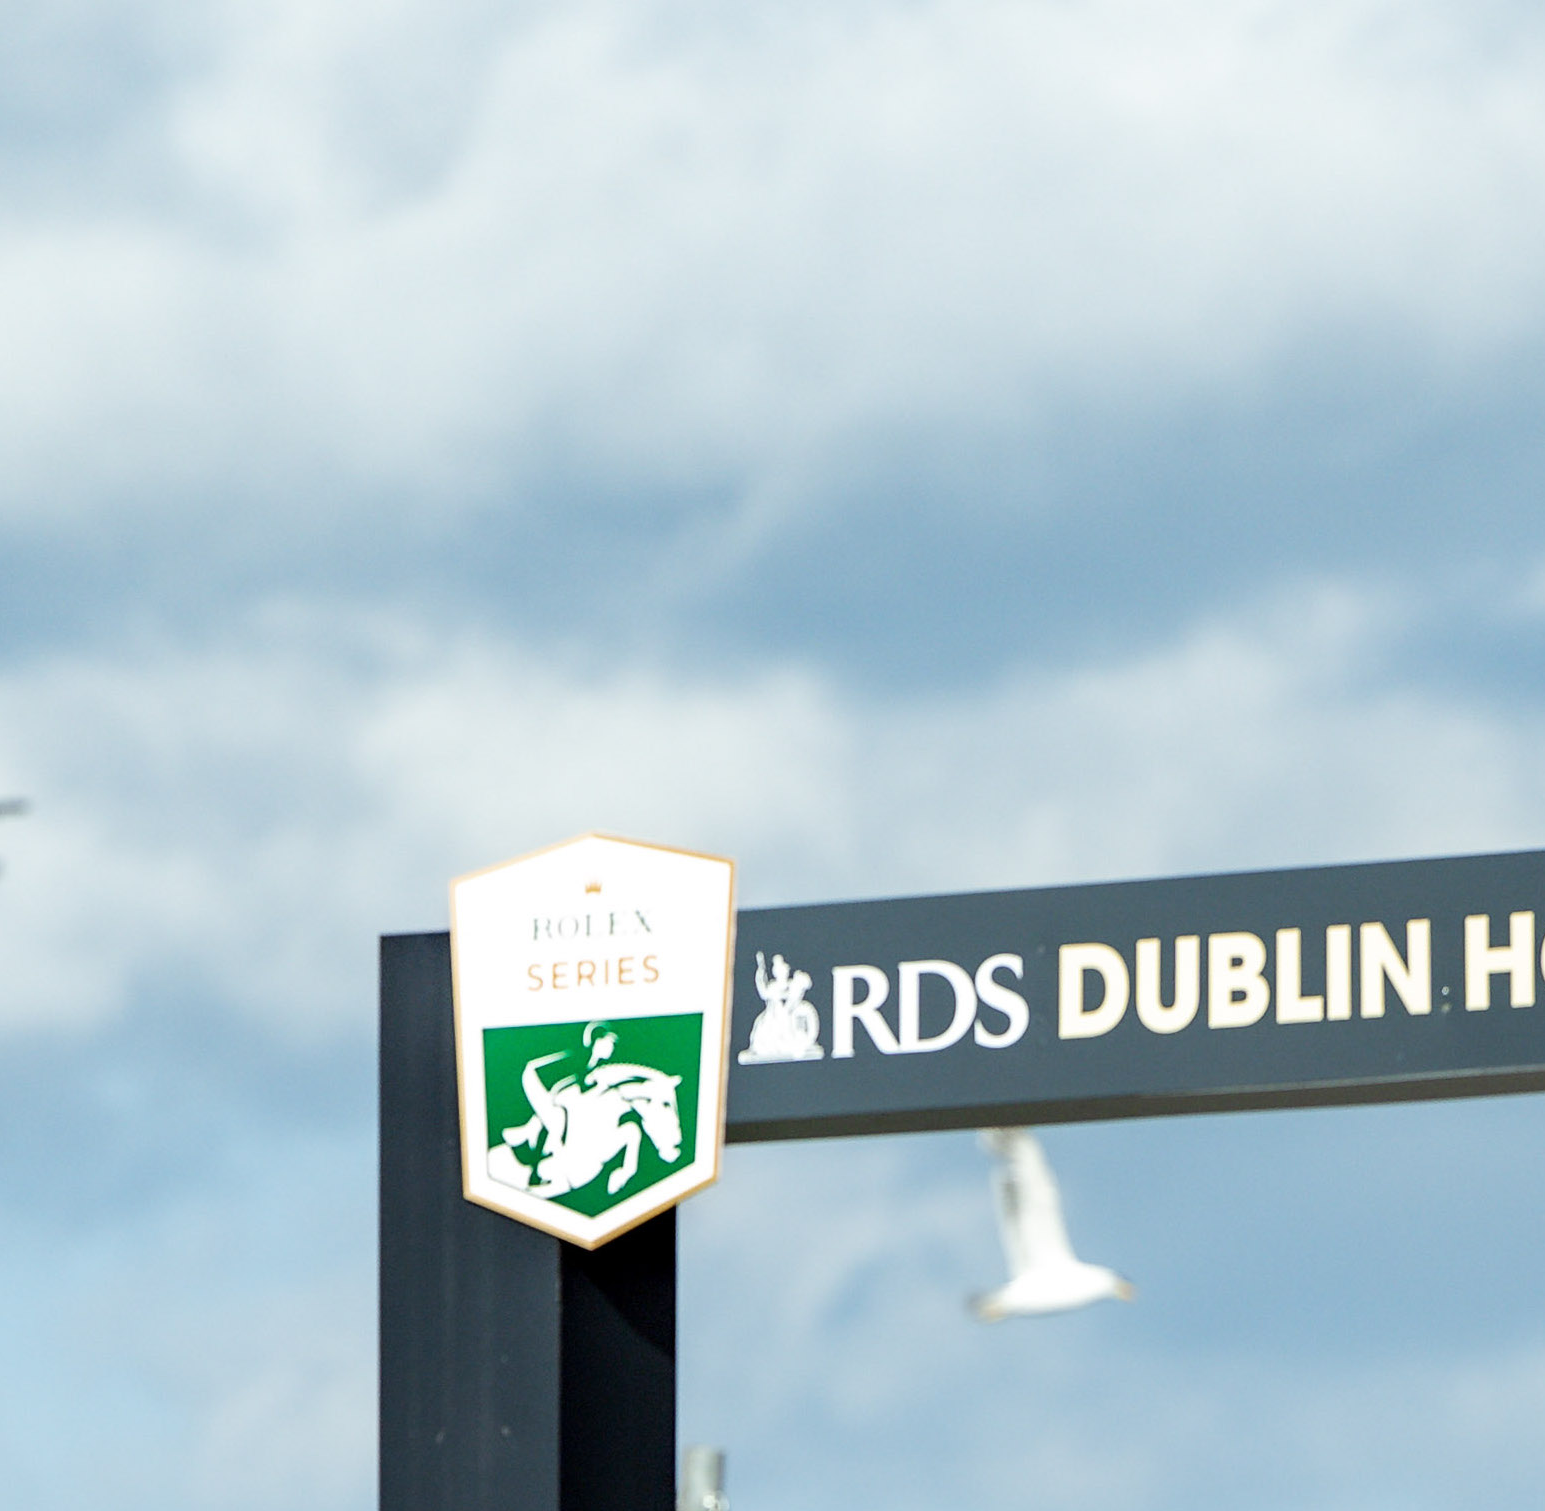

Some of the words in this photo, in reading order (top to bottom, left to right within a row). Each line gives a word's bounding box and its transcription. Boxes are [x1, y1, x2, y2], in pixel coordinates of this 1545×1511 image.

[532, 910, 654, 942] ROLEX
[527, 955, 661, 991] SERIES
[831, 953, 1030, 1059] RDS
[1057, 918, 1432, 1041] DUBLIN
